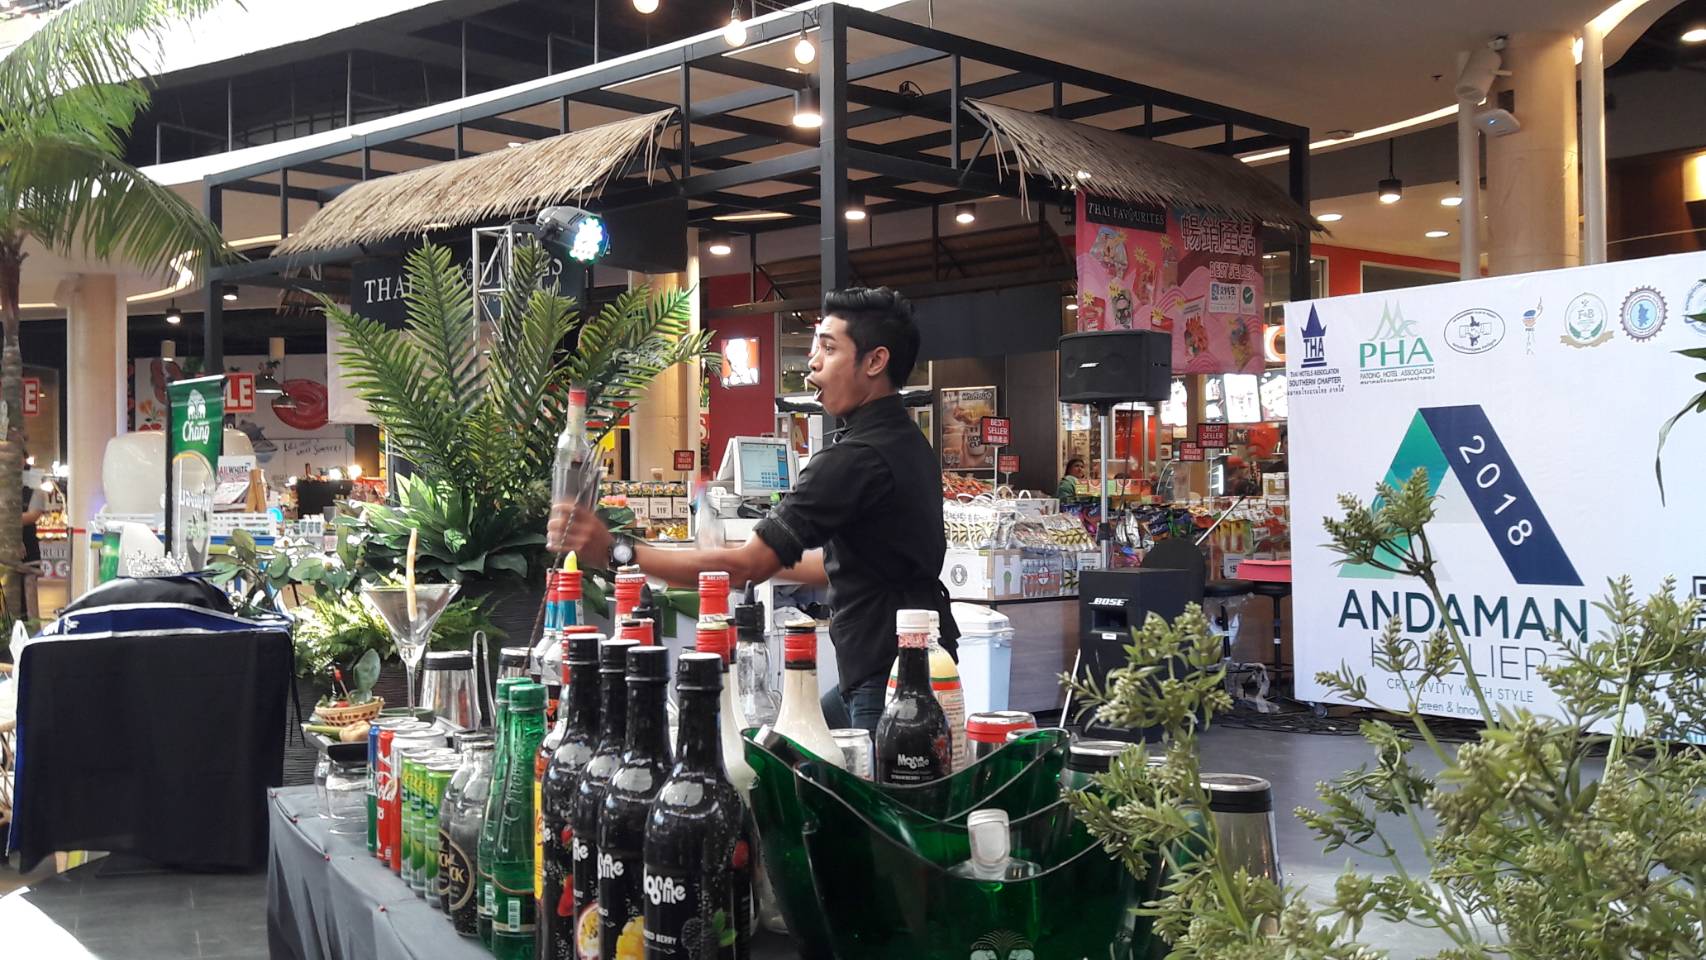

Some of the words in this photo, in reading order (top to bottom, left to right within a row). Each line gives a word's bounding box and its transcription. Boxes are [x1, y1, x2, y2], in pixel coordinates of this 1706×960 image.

[1088, 203, 1110, 217] THAI
[363, 273, 415, 304] THAI
[1303, 338, 1325, 358] THA
[1360, 337, 1434, 368] PHA
[1401, 367, 1435, 377] ASSOCIATION
[1289, 378, 1316, 387] SOUTHERN
[1317, 376, 1342, 385] CHAPTER
[225, 377, 254, 407] LE
[182, 421, 210, 445] Chang
[988, 427, 1008, 435] SELLER
[1459, 434, 1533, 546] 2018
[1090, 597, 1127, 606] BOSE
[1338, 589, 1588, 643] ANDAMAN
[1371, 637, 1548, 681] HOELIER
[1498, 688, 1534, 703] STYLE
[1446, 701, 1453, 713] &
[656, 933, 677, 946] BERRY
